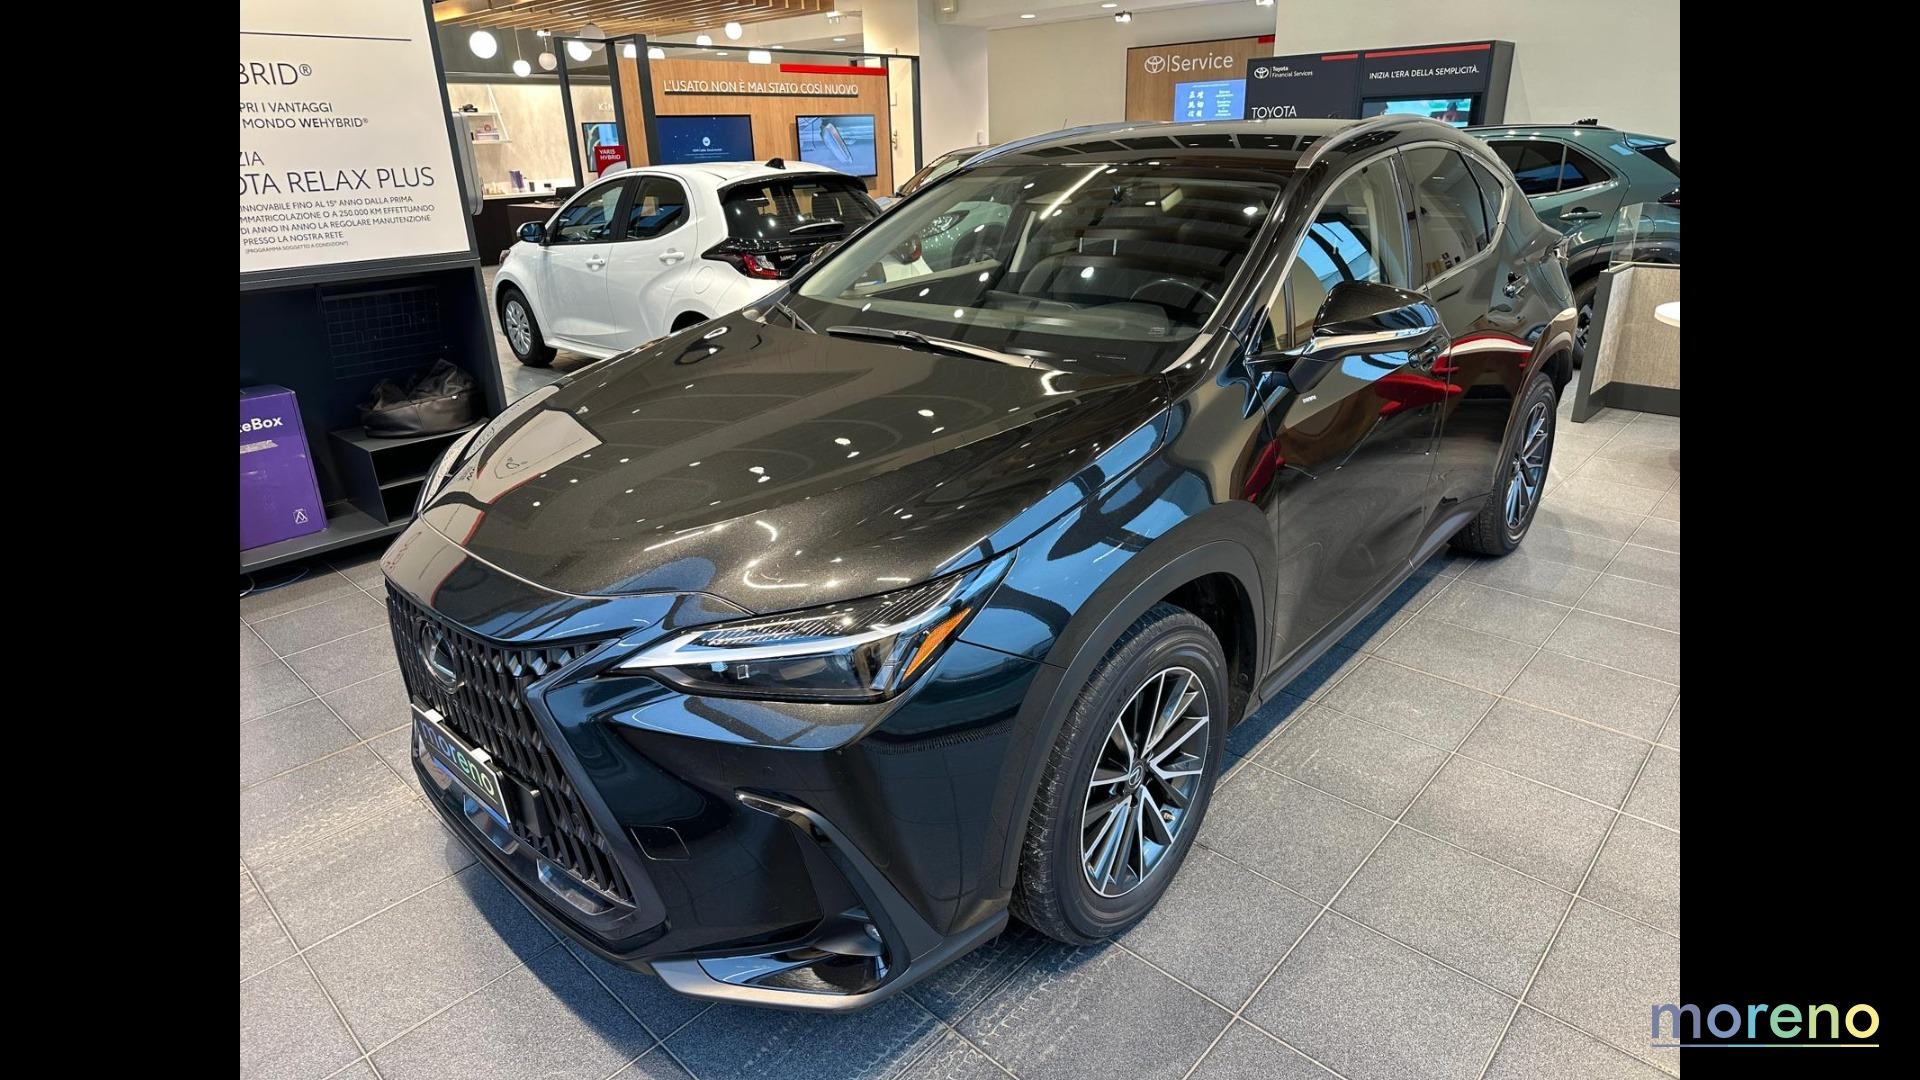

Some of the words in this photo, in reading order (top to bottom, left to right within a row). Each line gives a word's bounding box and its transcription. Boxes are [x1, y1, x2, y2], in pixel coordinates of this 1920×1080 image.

[1171, 52, 1234, 72] Service
[1369, 71, 1390, 80] INIZIA
[1390, 70, 1410, 78] L'ERA
[1411, 68, 1434, 77] DELLA
[663, 80, 708, 92] L'USATO
[711, 81, 737, 92] NON
[739, 79, 745, 92] È
[747, 81, 767, 93] MAI
[768, 82, 798, 93] STATO
[800, 80, 823, 94] COSÌ
[824, 84, 859, 95] NUOVO
[261, 102, 266, 113] I
[267, 102, 333, 113] VANTAGGI
[1251, 105, 1297, 119] TOYOTA
[242, 118, 296, 129] MONDO
[287, 169, 371, 193] RELAX
[376, 166, 435, 189] PLUS
[292, 201, 313, 209] FINO
[339, 198, 363, 206] ANNO
[364, 197, 389, 205] DALLA
[389, 195, 413, 203] PRIMA
[322, 210, 330, 218] O
[370, 207, 382, 215] KM
[383, 204, 435, 214] EFFETTUANDO
[251, 225, 279, 234] ANNO
[280, 224, 290, 232] IN
[291, 222, 317, 231] ANNO
[318, 221, 329, 229] LA
[330, 219, 371, 228] REGOLARE
[372, 214, 432, 226] MANUTENZIONE
[243, 236, 276, 246] PRESSO
[277, 235, 289, 243] LA
[289, 233, 324, 242] NOSTRA
[324, 231, 344, 239] RETE
[240, 417, 284, 433] eBox
